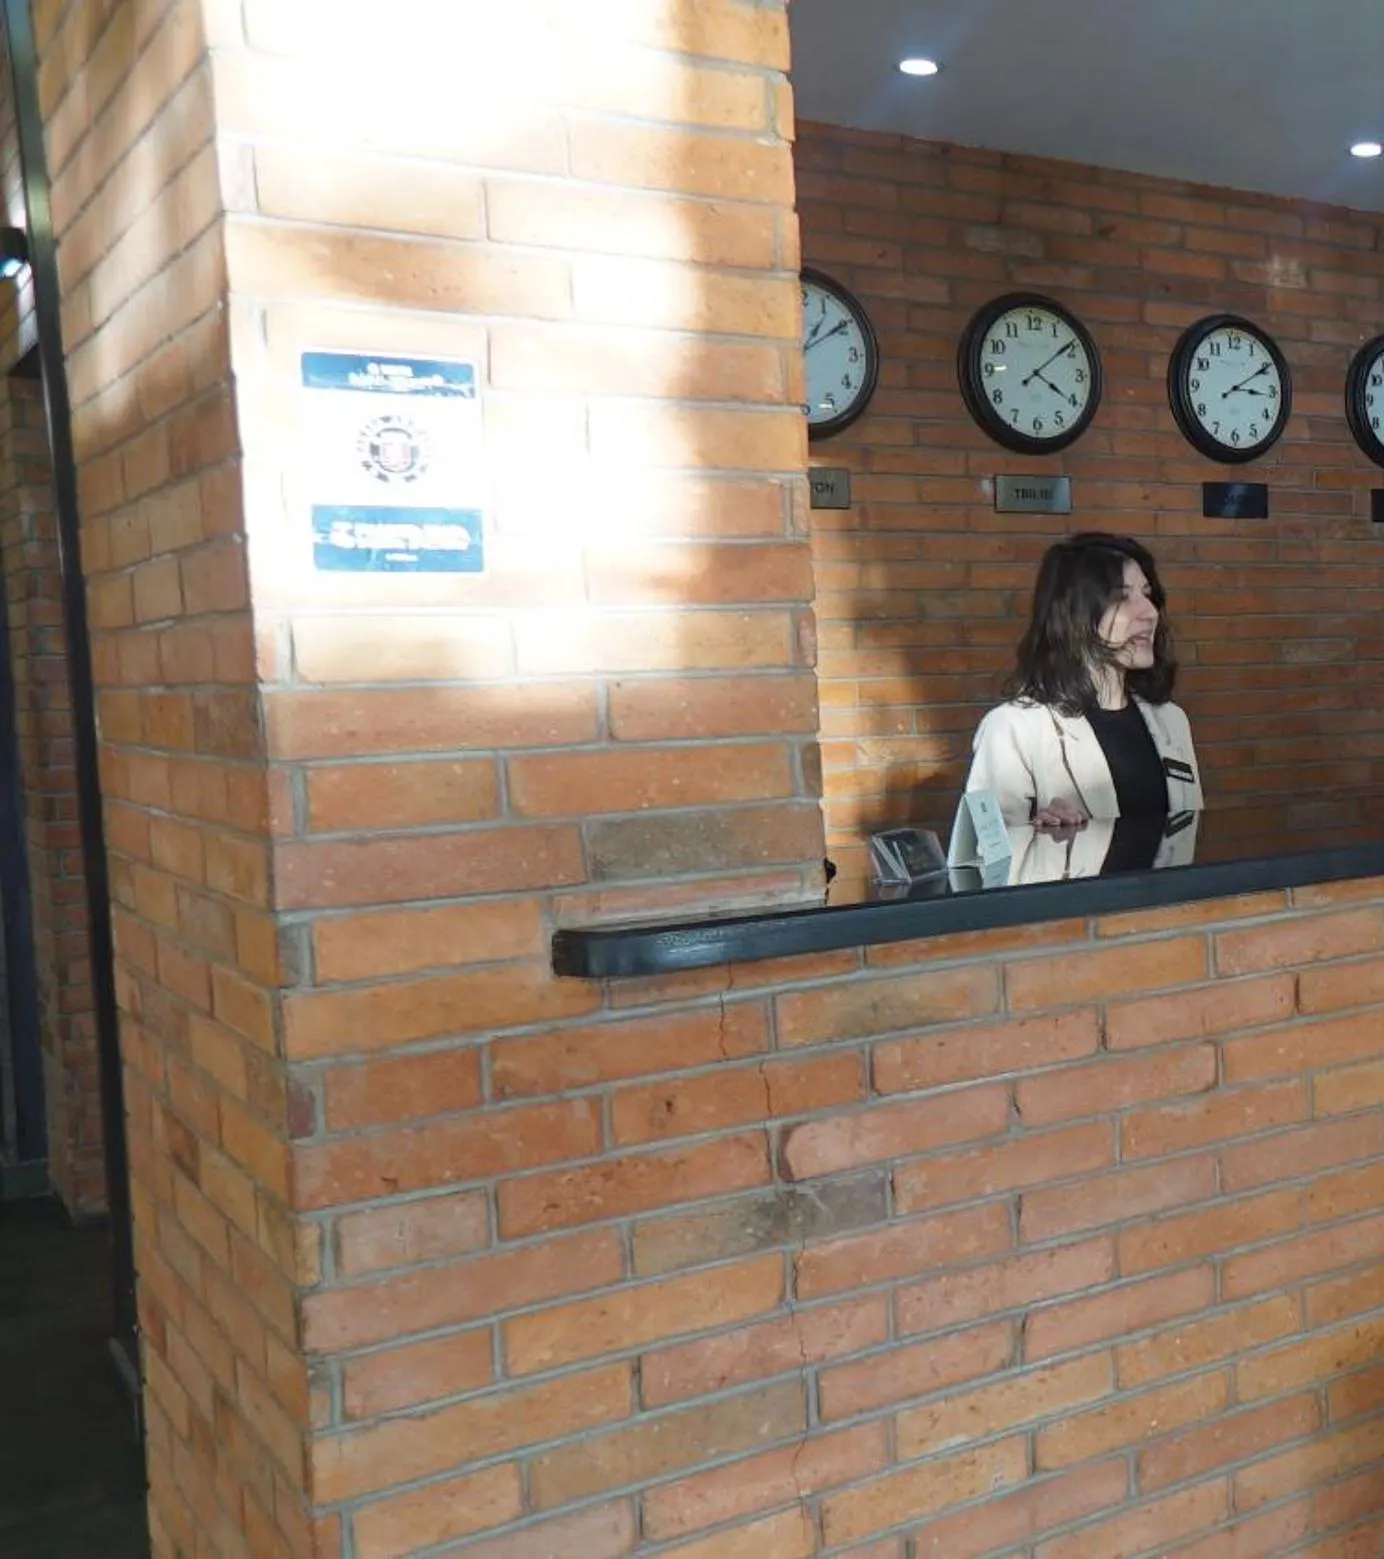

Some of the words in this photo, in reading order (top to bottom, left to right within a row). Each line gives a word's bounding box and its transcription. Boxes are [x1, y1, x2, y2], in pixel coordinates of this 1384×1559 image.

[821, 297, 826, 315] 1
[1005, 322, 1018, 338] 11
[1025, 315, 1042, 331] 12
[1052, 323, 1059, 337] 1
[991, 339, 1006, 354] 10
[1067, 342, 1076, 358] 2
[1210, 342, 1220, 356] 11
[1228, 336, 1241, 350] 12
[1249, 343, 1254, 356] 1
[848, 346, 858, 363] 3
[985, 363, 994, 377] 9
[1197, 357, 1210, 371] 10
[1261, 362, 1270, 375] 2
[841, 372, 851, 389] 4
[1075, 368, 1084, 383] 3
[1371, 374, 1382, 386] 10
[1191, 379, 1200, 392] 9
[1268, 385, 1276, 399] 3
[825, 392, 835, 407] 5
[993, 389, 1003, 404] 8
[1068, 393, 1077, 407] 4
[1367, 393, 1373, 406] 9
[1010, 408, 1019, 423] 7
[1197, 403, 1206, 417] 8
[1262, 407, 1270, 421] 4
[1033, 416, 1043, 430] 6
[1055, 410, 1064, 425] 5
[1372, 416, 1379, 429] 8
[1213, 421, 1220, 435] 7
[1231, 428, 1239, 442] 6
[1249, 423, 1258, 437] 5
[811, 481, 835, 495] ON
